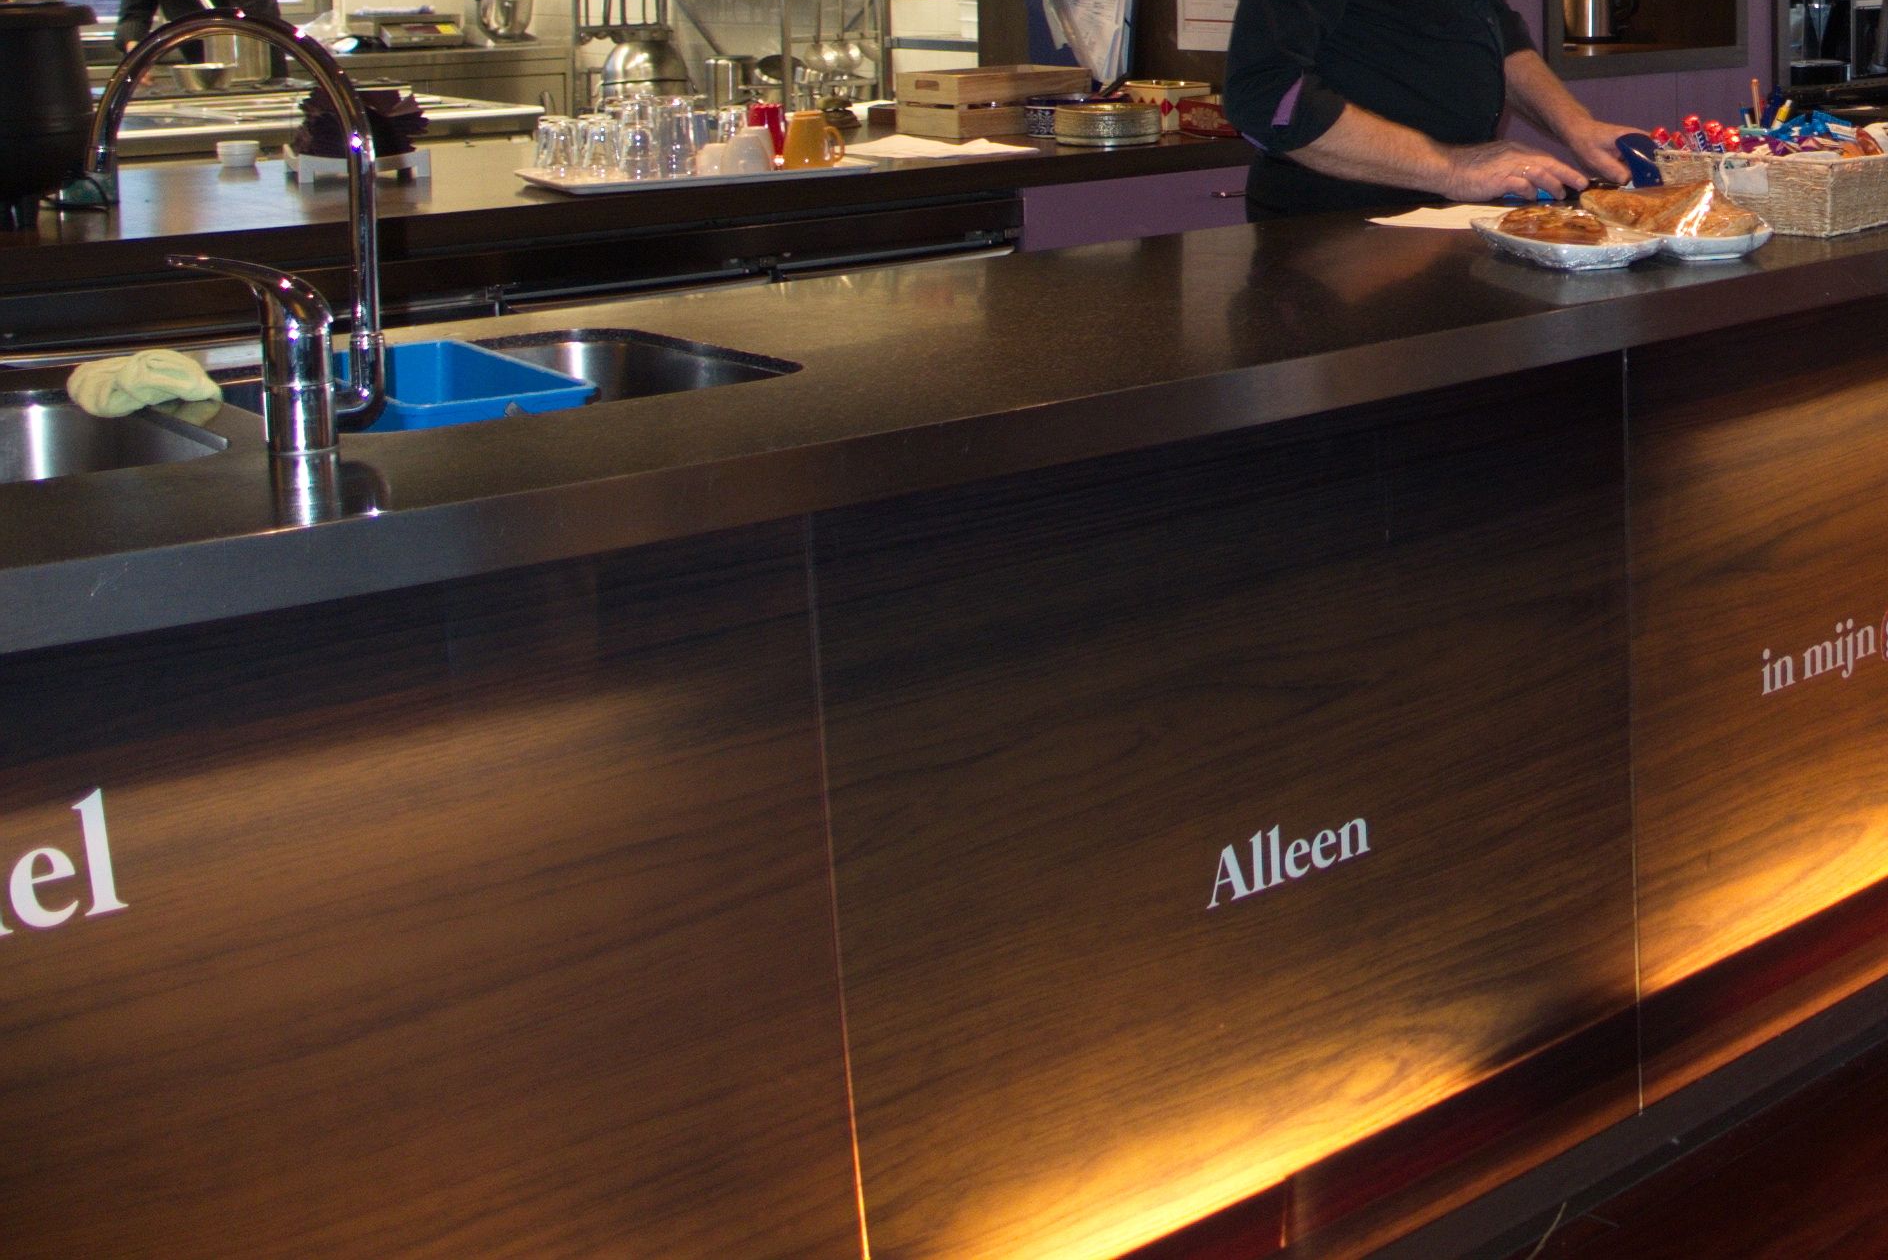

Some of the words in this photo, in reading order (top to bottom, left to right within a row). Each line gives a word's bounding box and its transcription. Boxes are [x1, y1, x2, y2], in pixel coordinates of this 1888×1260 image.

[1762, 647, 1795, 696] in
[1803, 618, 1876, 678] mijn
[0, 787, 130, 937] el
[1206, 818, 1371, 909] Alleen
